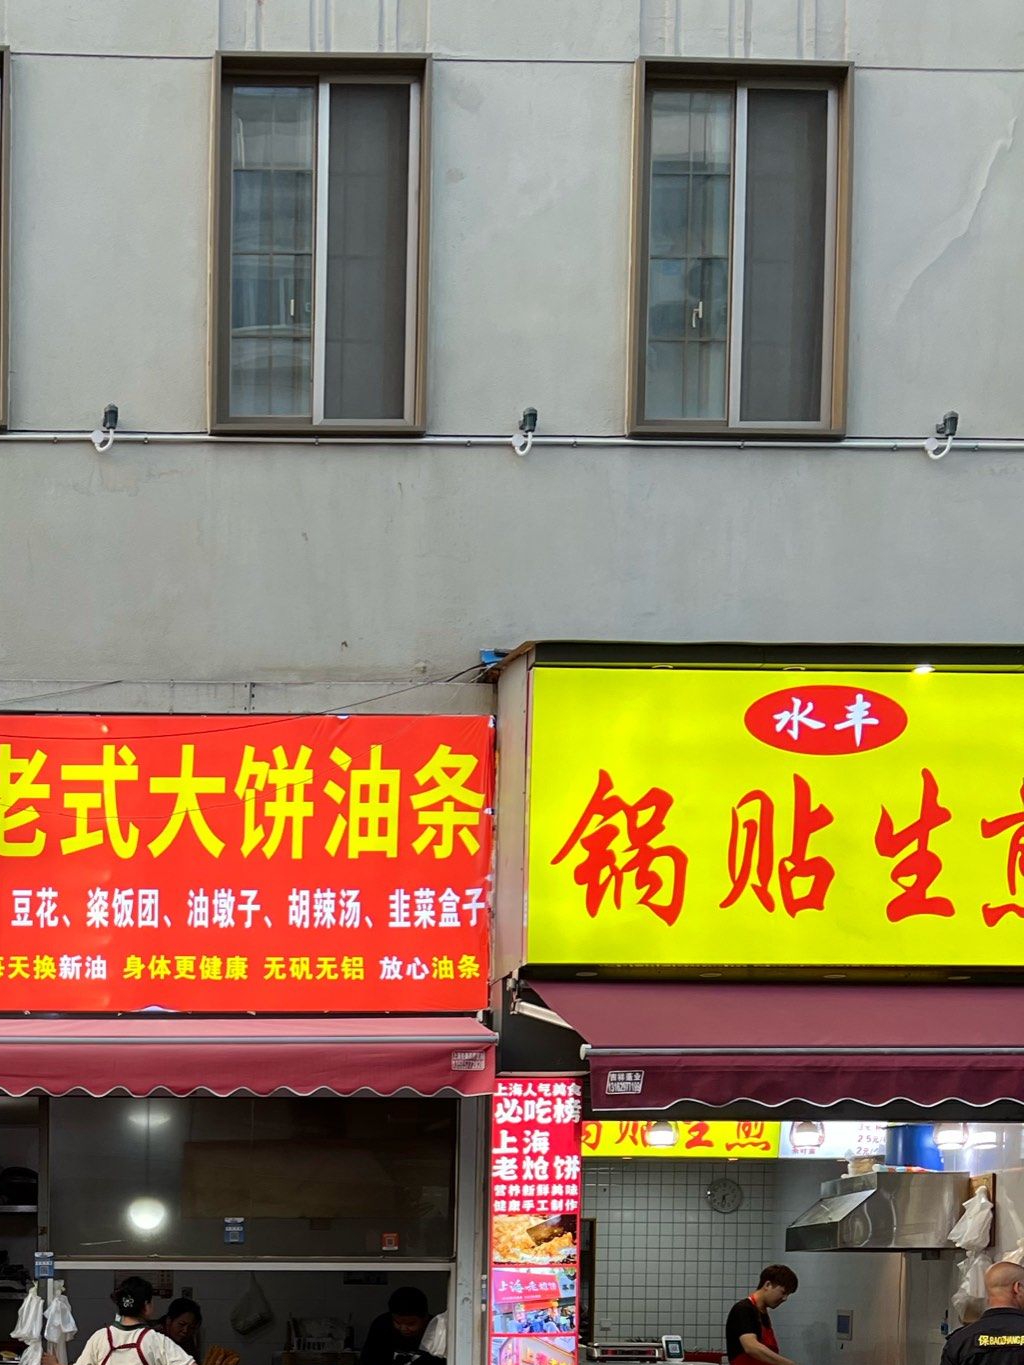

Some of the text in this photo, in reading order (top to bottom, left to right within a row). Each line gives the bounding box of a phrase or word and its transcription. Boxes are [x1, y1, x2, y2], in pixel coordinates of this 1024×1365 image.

[772, 693, 880, 748] 水丰
[122, 954, 249, 981] 身体更健康
[263, 955, 366, 981] 无矾无铝
[379, 956, 481, 981] 放心油条
[493, 1083, 582, 1097] 上海人气美食
[494, 1097, 582, 1124] 必吃榜
[492, 1129, 550, 1155] 上海
[492, 1156, 580, 1181] 老炝饼
[493, 1183, 579, 1197] 营养新鲜美味
[493, 1199, 579, 1212] 健康手工制作
